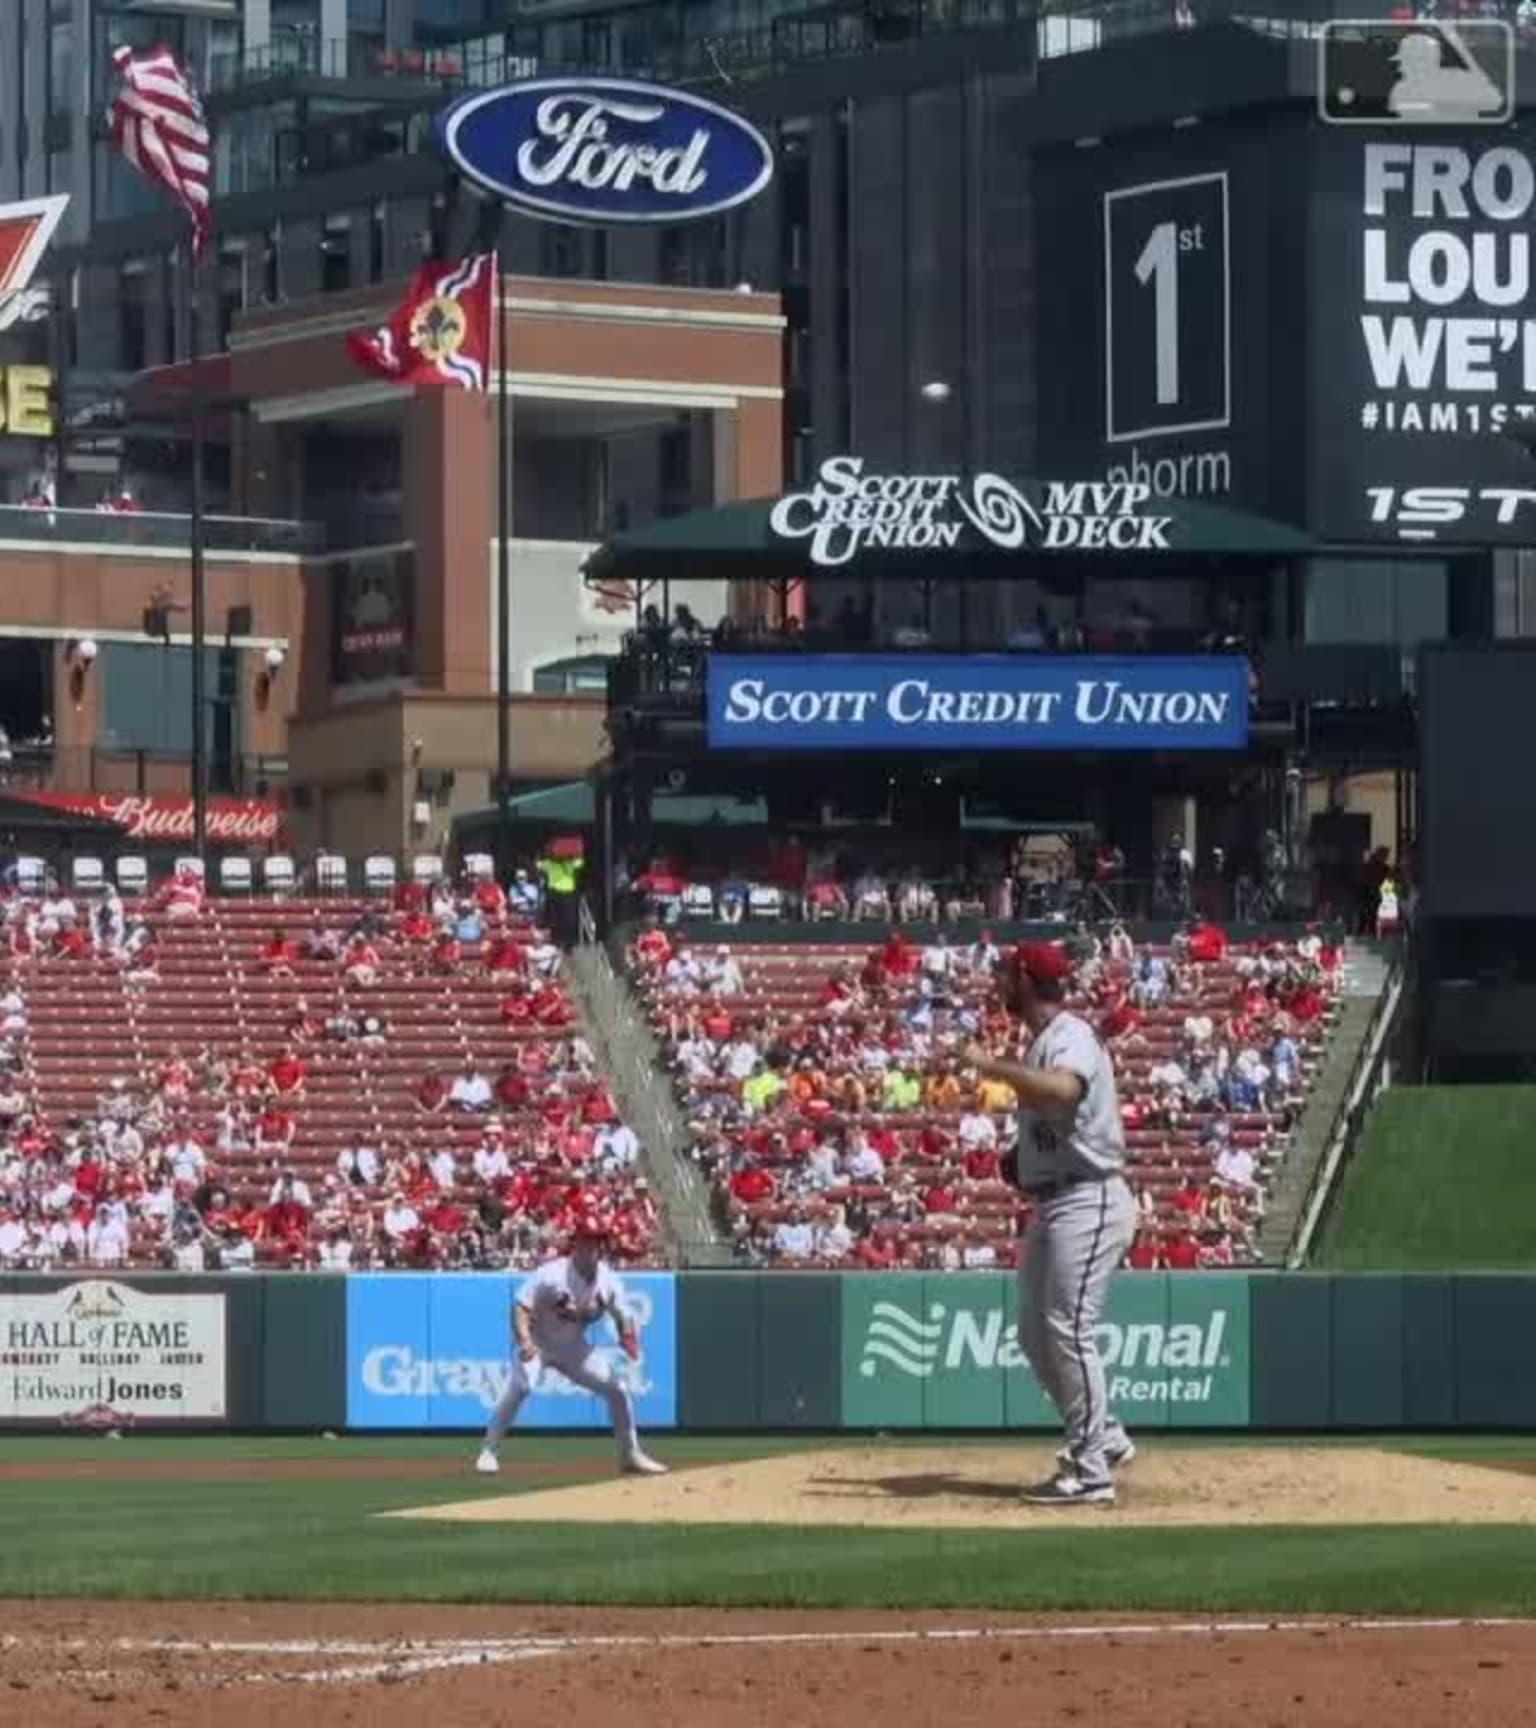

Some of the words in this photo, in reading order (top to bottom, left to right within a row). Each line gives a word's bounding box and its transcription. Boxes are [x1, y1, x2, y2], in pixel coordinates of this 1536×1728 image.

[517, 93, 711, 193] Ford
[1364, 143, 1535, 219] FRO
[1364, 230, 1530, 305] LOU
[1044, 482, 1151, 515] MVP
[1043, 515, 1172, 549] DECK
[8, 1322, 84, 1348] HALL
[88, 1324, 107, 1350] of
[114, 1322, 189, 1348] FAME
[944, 1309, 1227, 1368] Naonal
[14, 1374, 102, 1400] Edward
[107, 1375, 184, 1402] Jones
[1110, 1375, 1213, 1401] Rental
